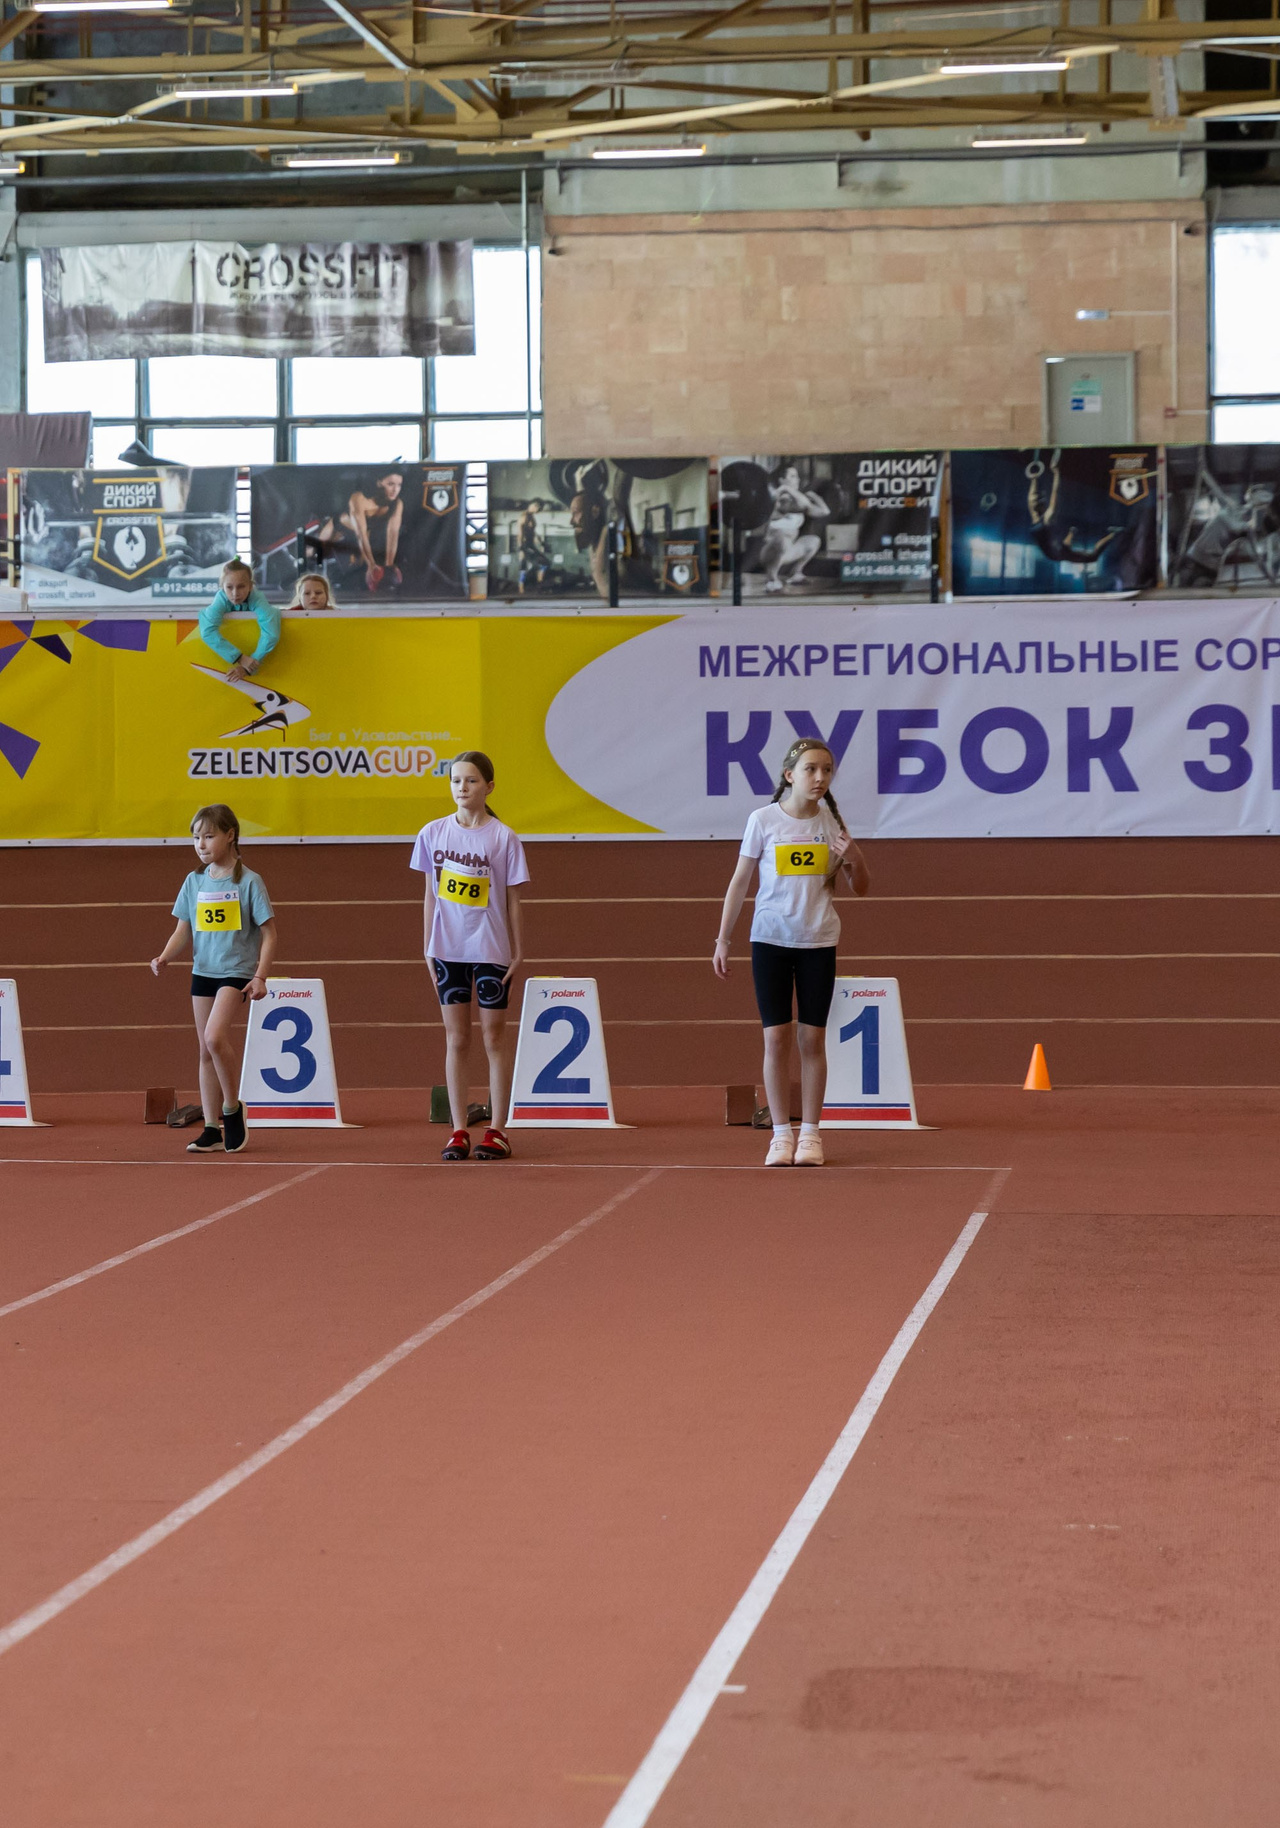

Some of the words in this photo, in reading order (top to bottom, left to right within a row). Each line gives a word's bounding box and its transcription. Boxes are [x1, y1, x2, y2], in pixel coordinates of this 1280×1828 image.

[217, 251, 402, 289] CROSSFIT
[857, 455, 937, 476] ДИКИЙ
[103, 482, 156, 496] ДИКИЙ
[858, 477, 937, 495] СПОРТ
[103, 495, 156, 507] СПОРТ
[699, 639, 1179, 678] МЕЖРЕГИОНАЛЬНЫЕ
[1195, 637, 1280, 671] СОР
[705, 706, 1140, 796] КУБОК
[1183, 703, 1280, 793] З
[790, 851, 815, 866] 62
[447, 879, 480, 898] 878
[204, 908, 226, 923] 35
[278, 989, 313, 1000] polanik
[551, 989, 586, 999] polanik
[851, 989, 887, 999] polanik
[260, 1006, 317, 1094] 3
[531, 1005, 591, 1094] 2
[839, 1005, 880, 1095] 1
